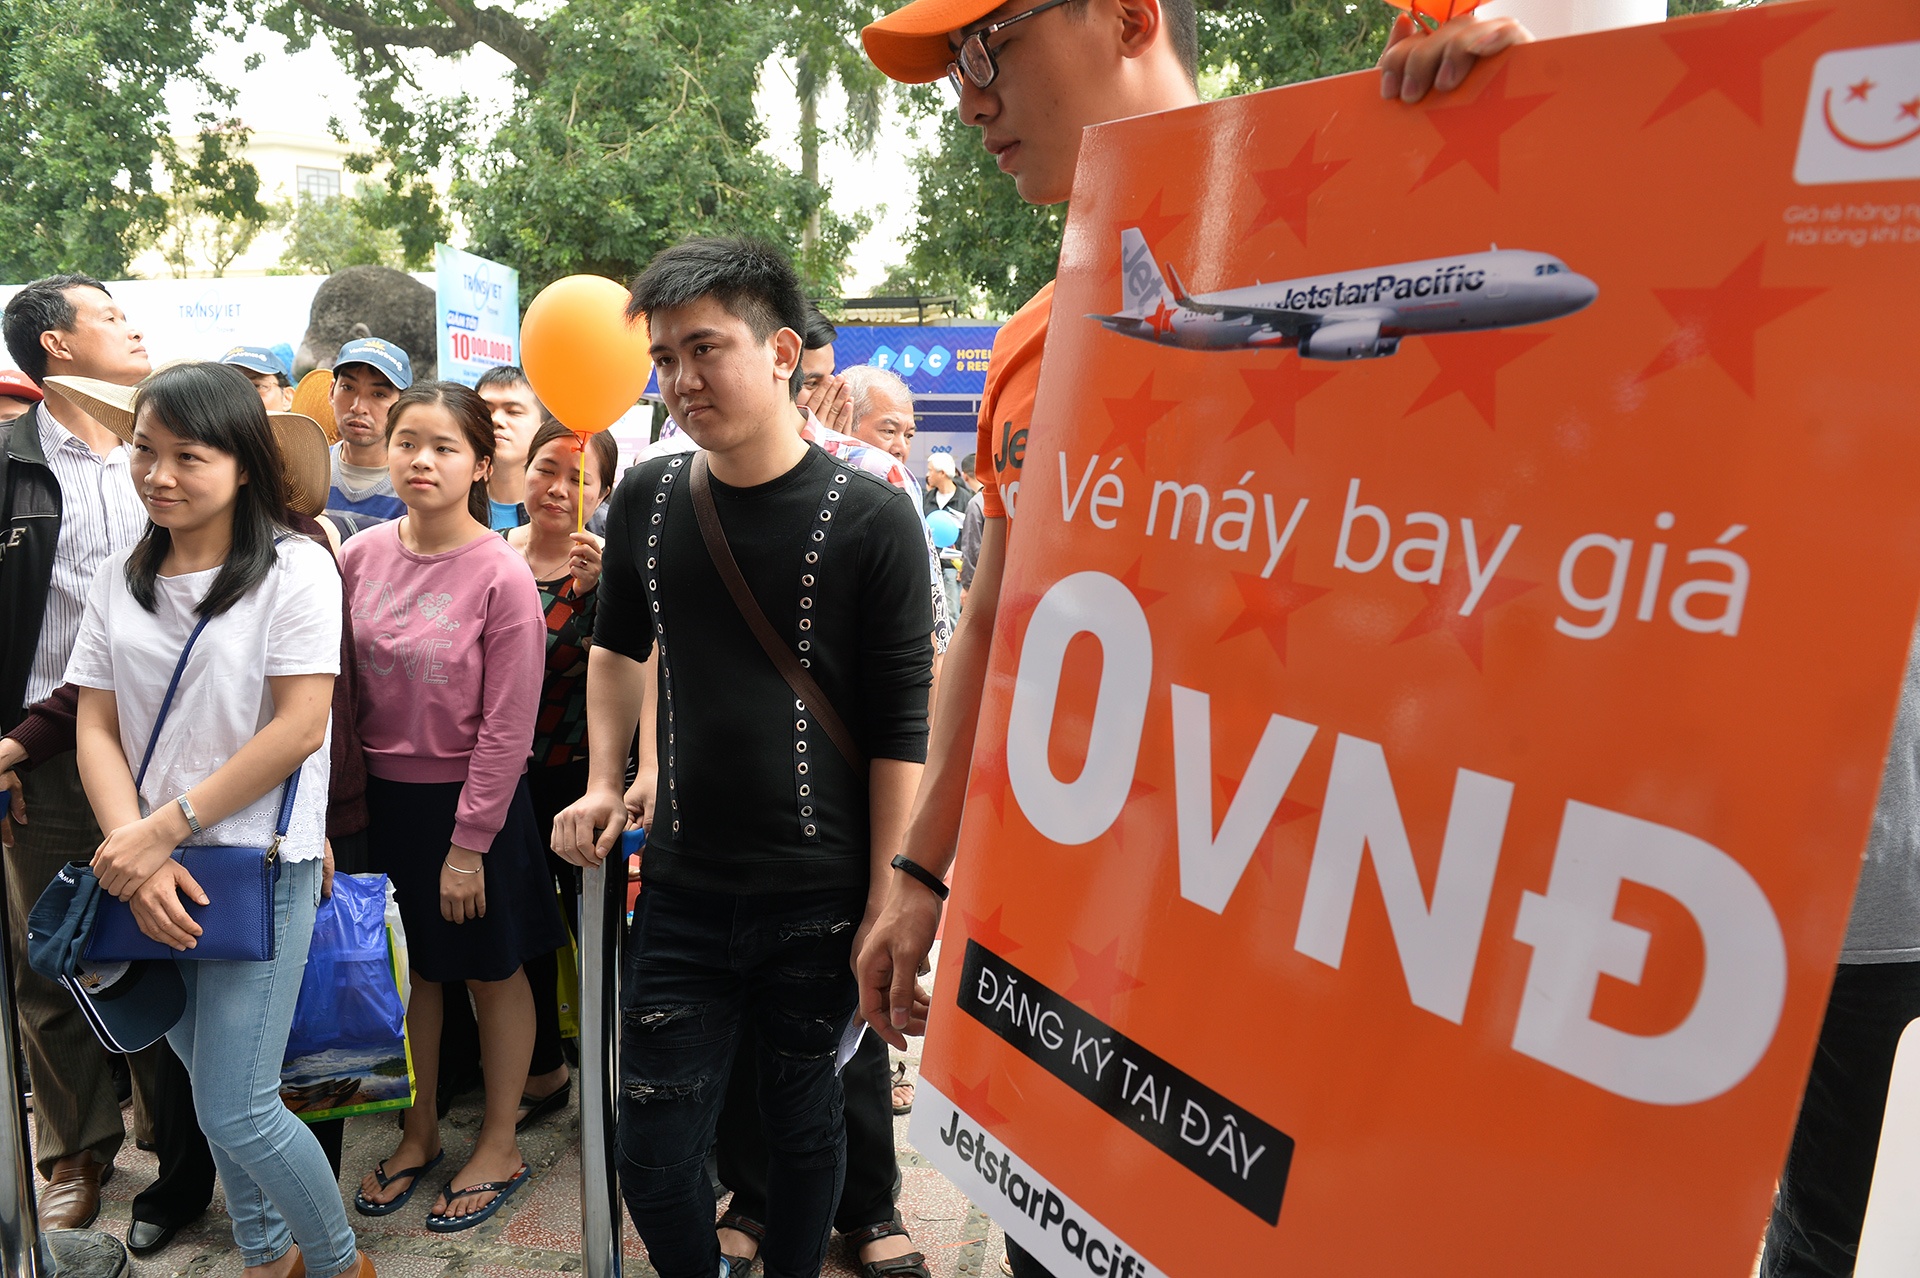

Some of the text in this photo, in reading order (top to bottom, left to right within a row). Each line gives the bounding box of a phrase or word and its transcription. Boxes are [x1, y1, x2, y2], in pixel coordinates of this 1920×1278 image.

[179, 302, 241, 320] TRANSVIET
[1123, 243, 1164, 316] Jet
[1276, 264, 1486, 311] JetstarPacific
[1057, 450, 1752, 640] Vé máy bay giá
[977, 966, 1266, 1180] ĐĂNG KÝ TẠI ĐÂY
